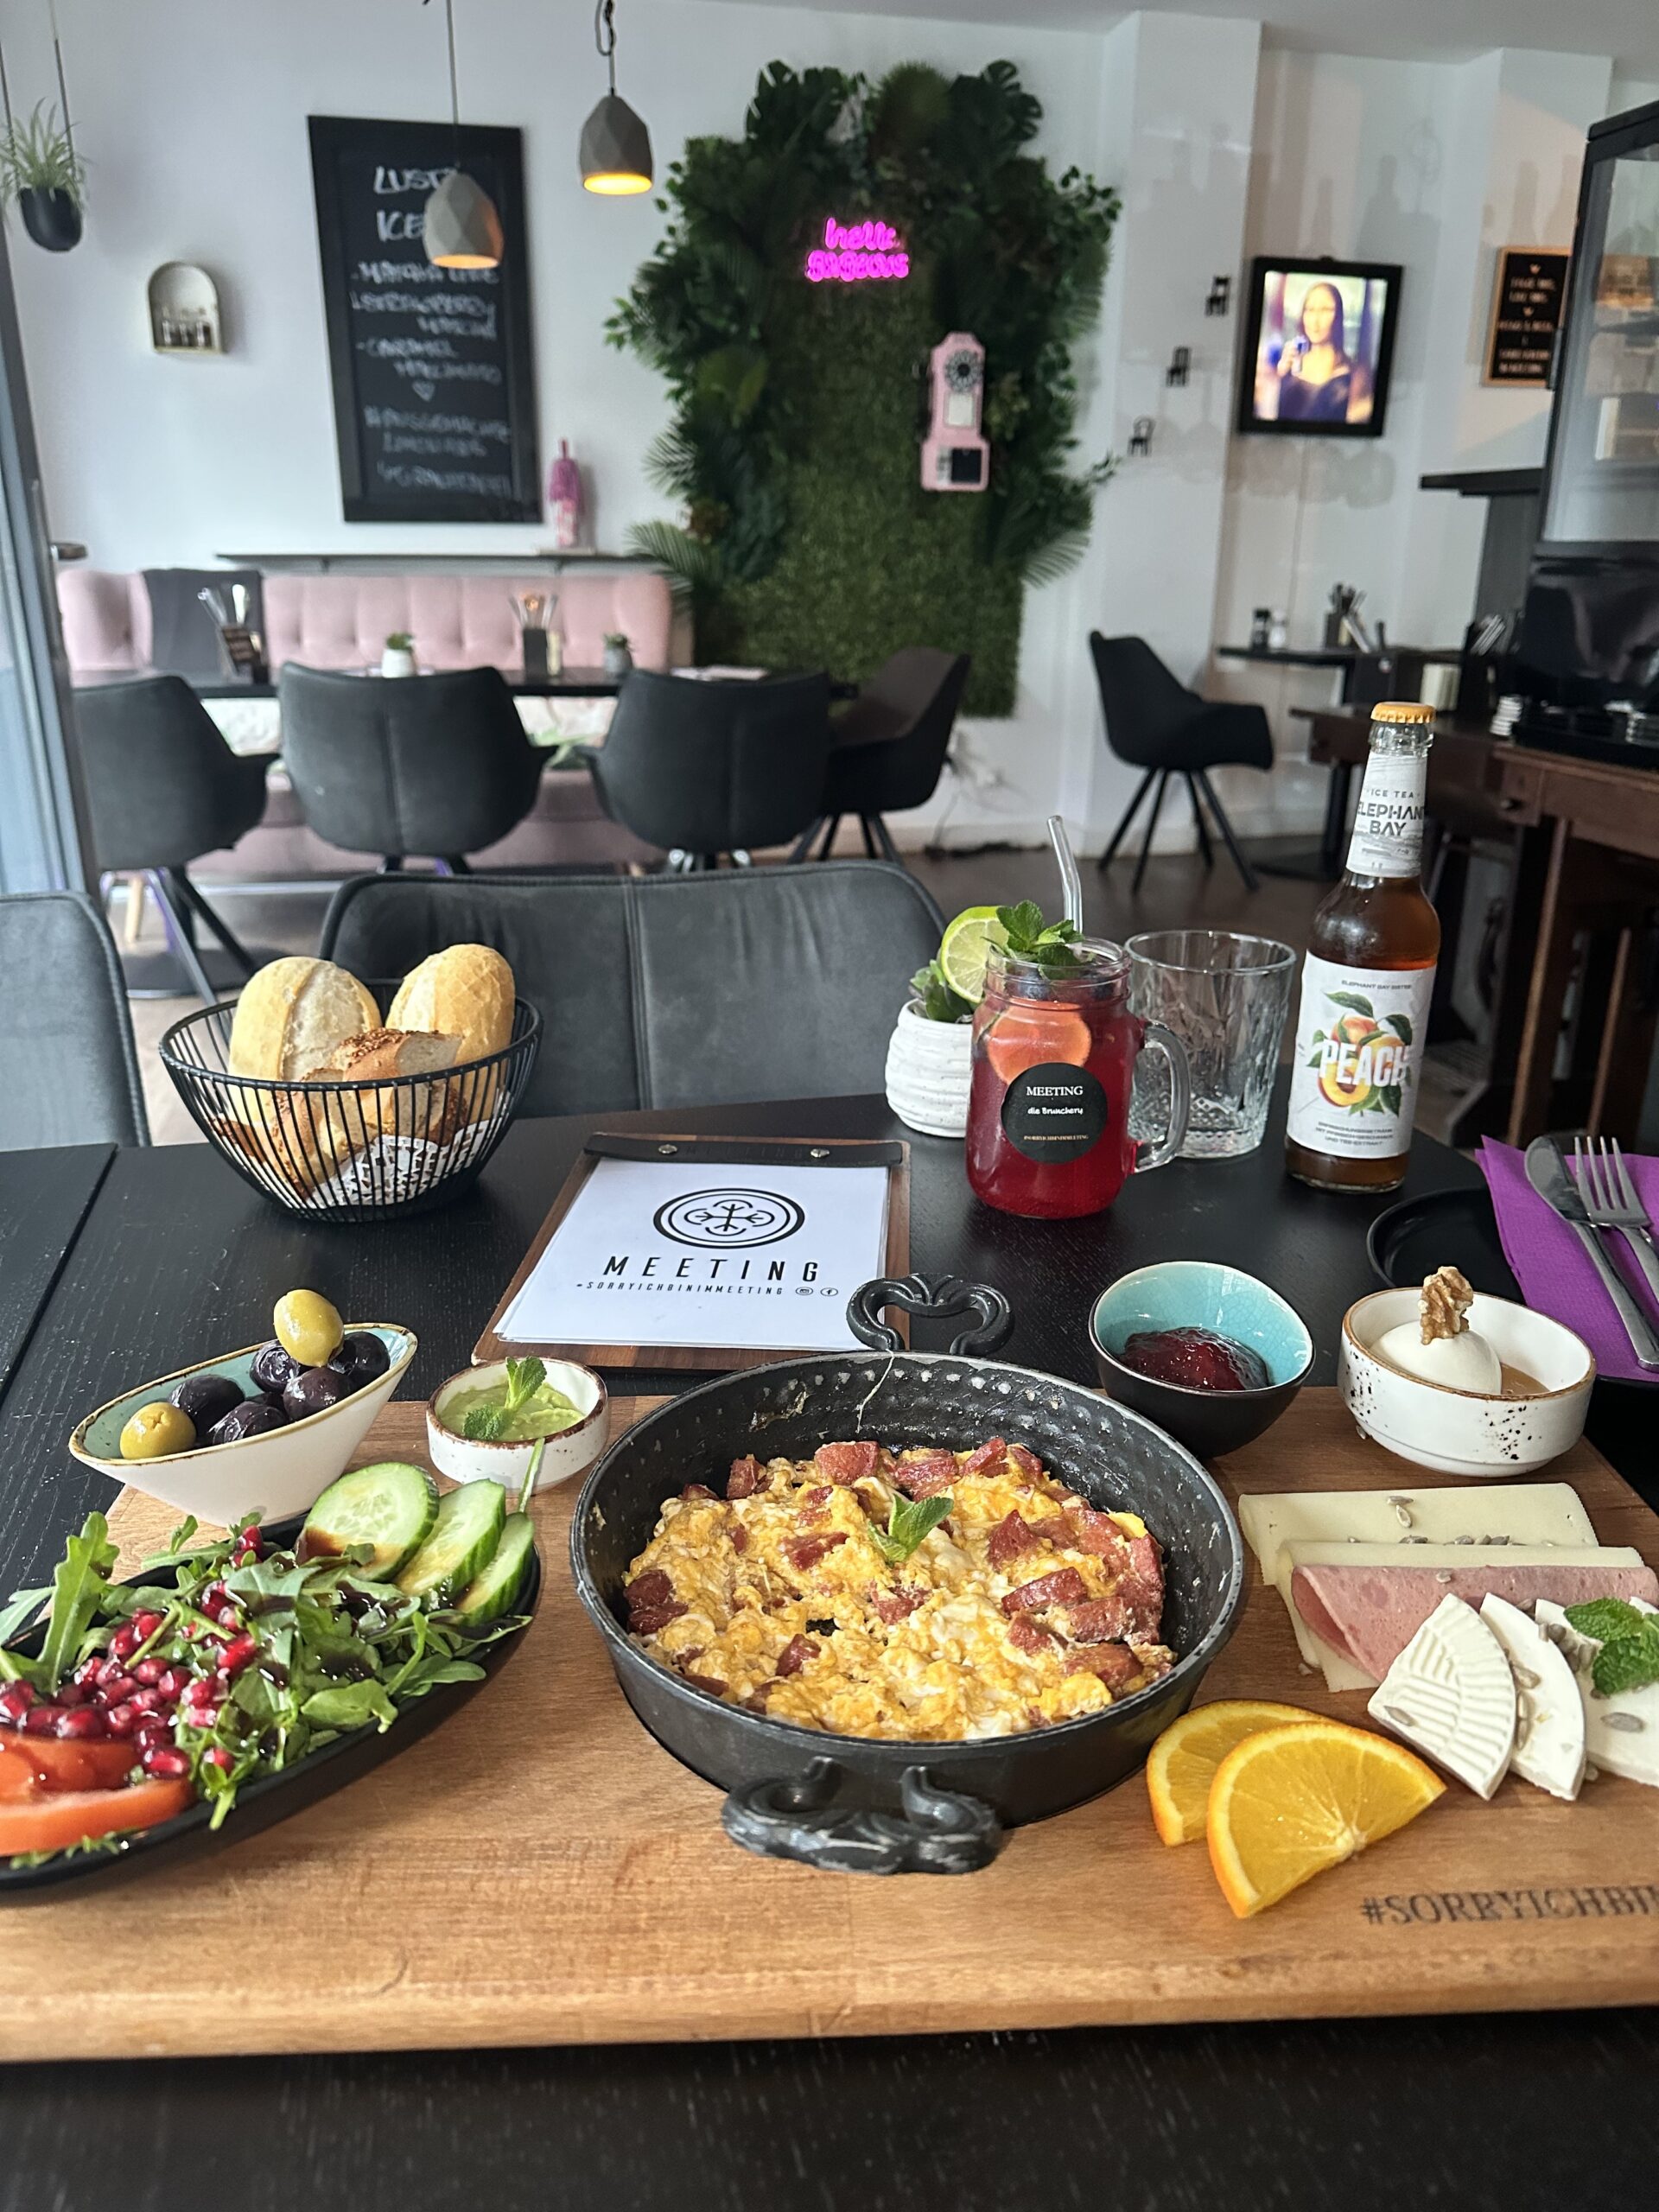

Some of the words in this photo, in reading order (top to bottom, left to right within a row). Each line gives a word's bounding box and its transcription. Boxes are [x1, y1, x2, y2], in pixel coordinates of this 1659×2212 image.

[1370, 788, 1389, 798] ICE
[1370, 820, 1407, 836] BAY
[1319, 1038, 1411, 1087] PEACH
[1026, 1085, 1084, 1096] MEETING
[1042, 1107, 1084, 1116] Brunchery
[602, 1255, 818, 1282] MEETING
